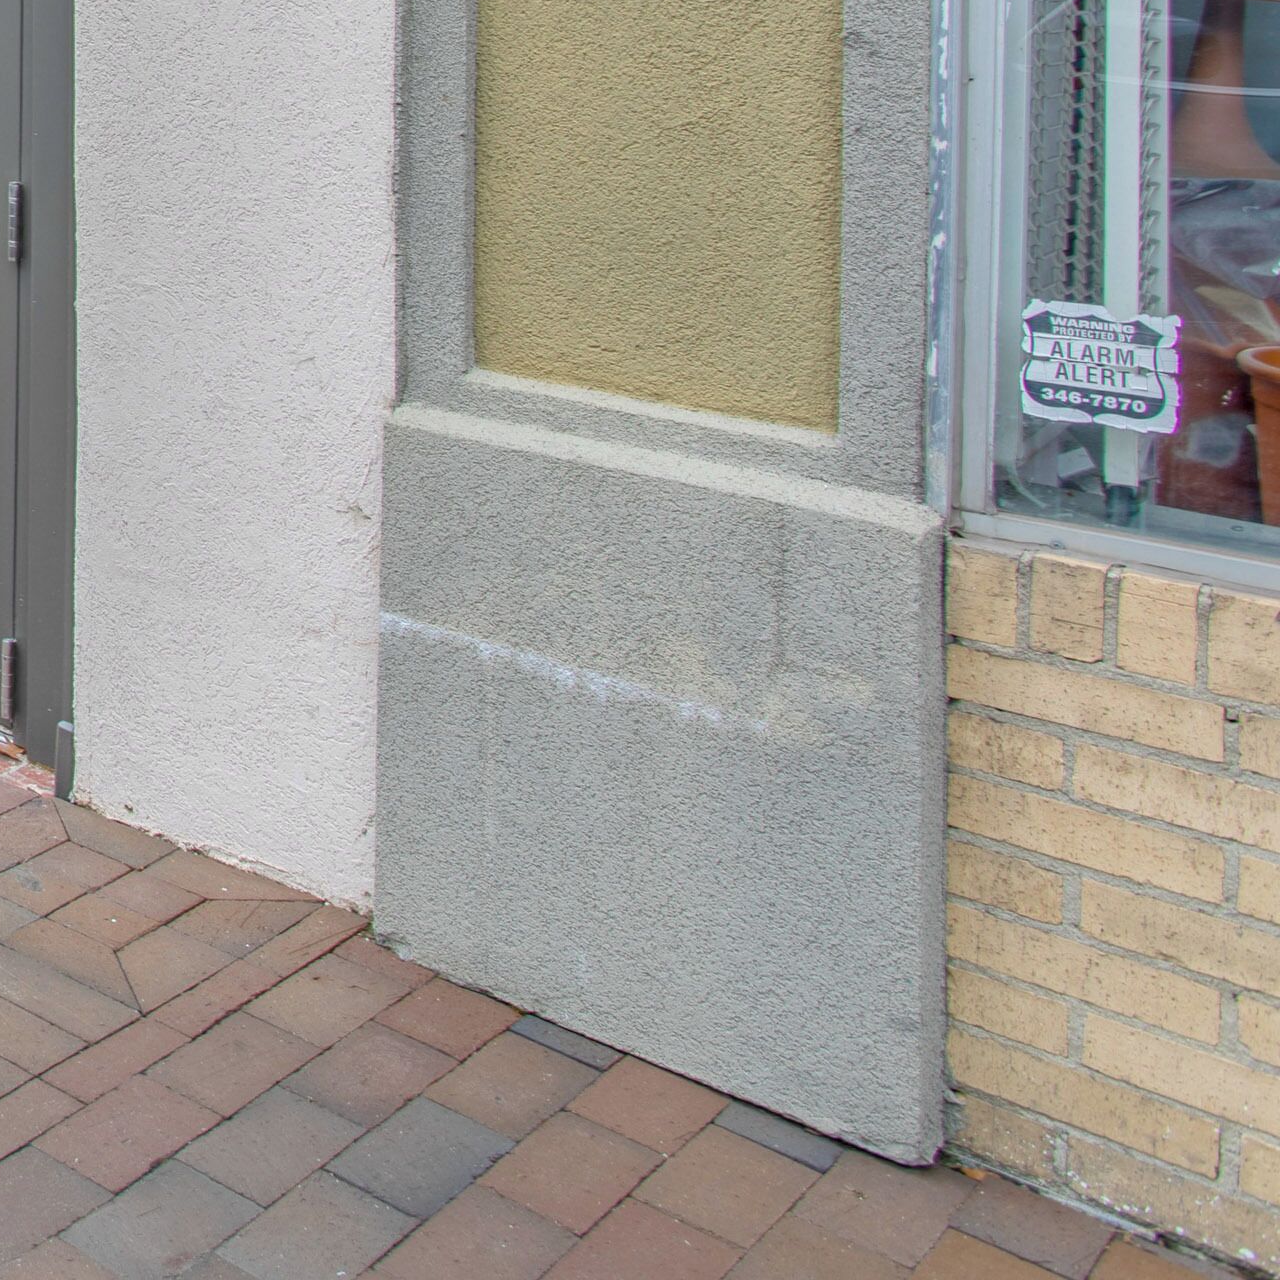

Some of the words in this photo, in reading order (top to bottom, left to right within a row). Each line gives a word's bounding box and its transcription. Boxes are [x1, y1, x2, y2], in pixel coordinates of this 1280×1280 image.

[1050, 317, 1136, 334] WARNING
[1053, 326, 1114, 340] PROTECTED
[1119, 334, 1133, 343] BY
[1050, 341, 1135, 367] ALARM
[1055, 363, 1130, 388] ALERT
[1041, 388, 1147, 413] 346-7870
